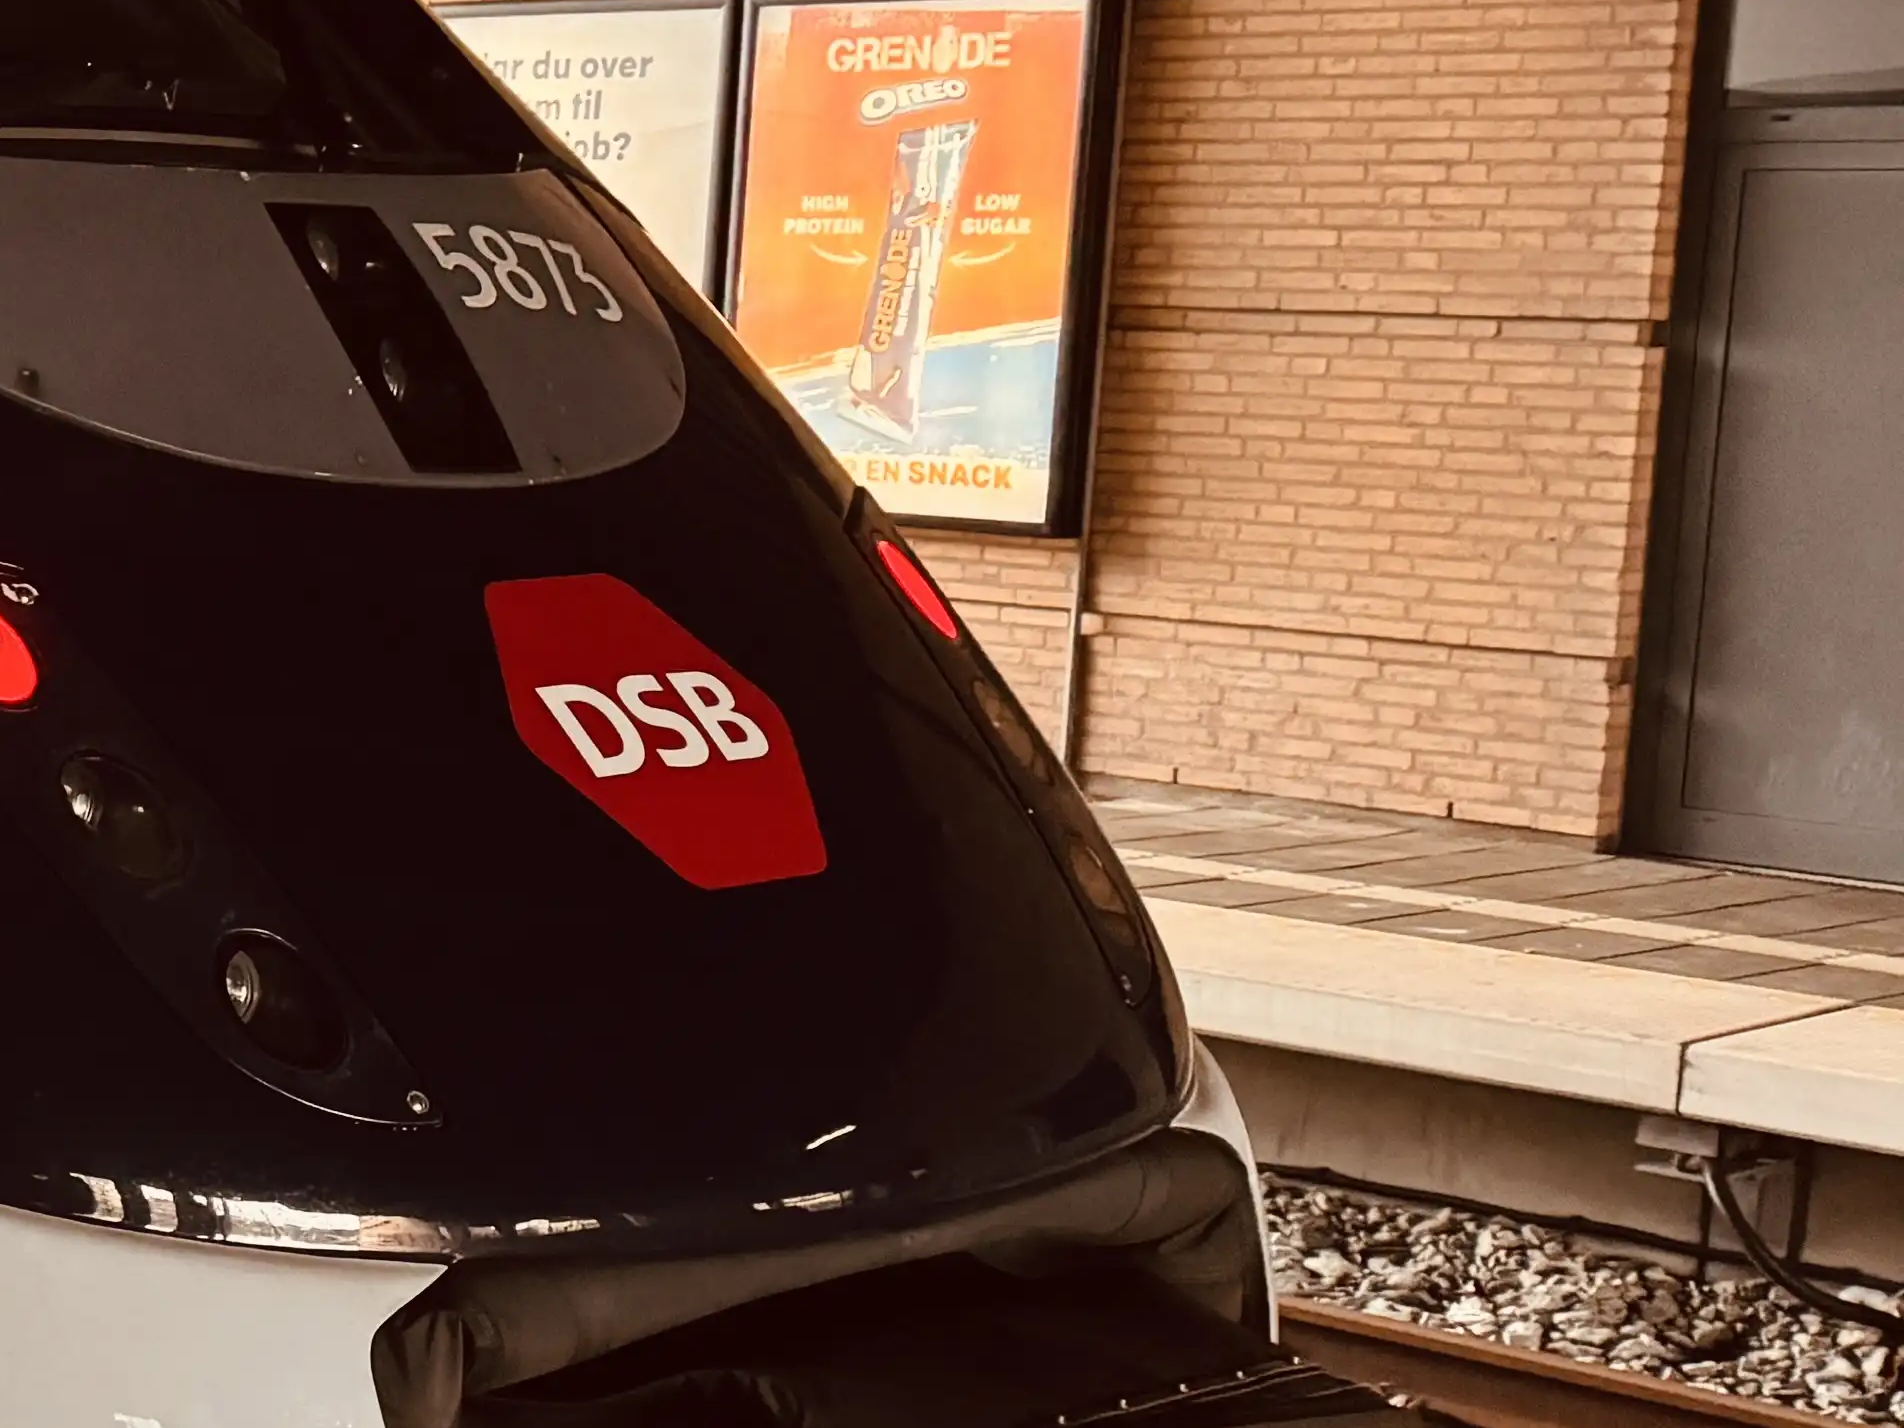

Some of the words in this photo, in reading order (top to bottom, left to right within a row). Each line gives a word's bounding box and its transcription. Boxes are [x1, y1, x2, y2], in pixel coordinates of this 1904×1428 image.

[483, 52, 524, 80] ar
[532, 49, 571, 80] du
[580, 55, 654, 79] over
[572, 89, 603, 121] til
[860, 79, 967, 120] OREO
[801, 195, 849, 212] HIGH
[975, 194, 1021, 211] LOW
[783, 217, 864, 235] PROTEIN
[961, 217, 1032, 235] SUGAR
[412, 222, 623, 322] 5873
[865, 459, 900, 483] EN
[908, 460, 1013, 489] SNACK
[535, 671, 769, 778] DSB
